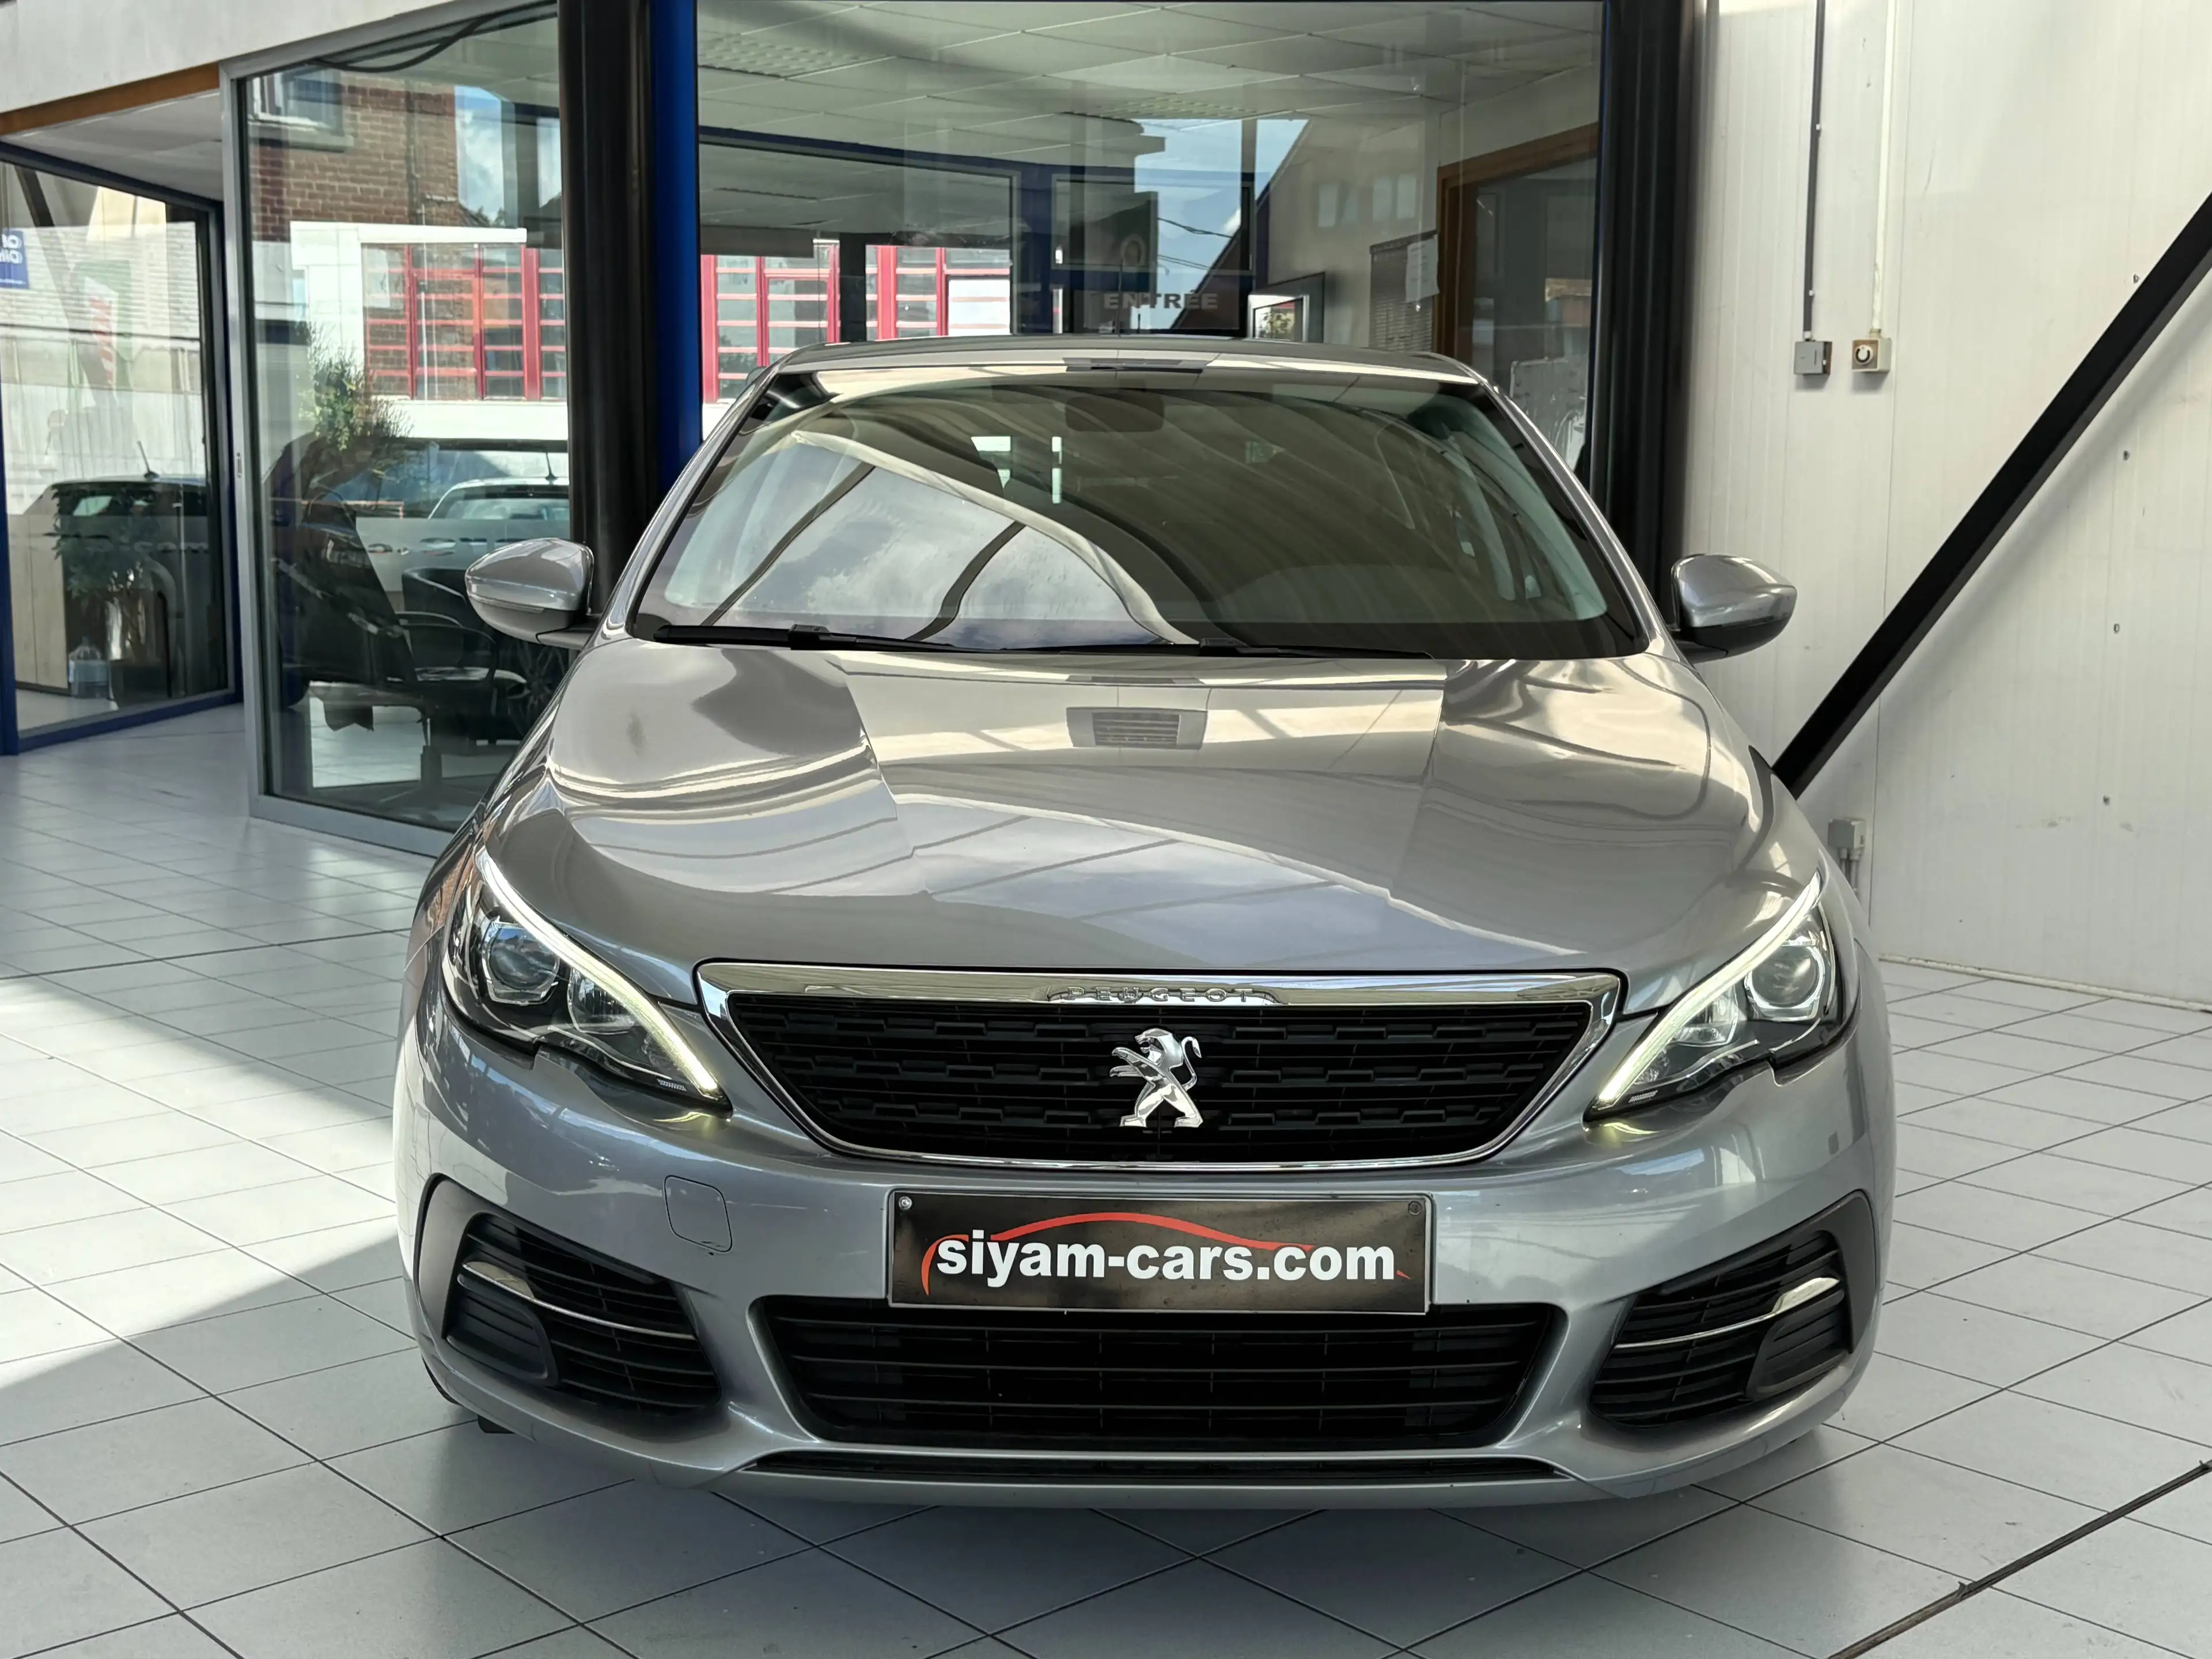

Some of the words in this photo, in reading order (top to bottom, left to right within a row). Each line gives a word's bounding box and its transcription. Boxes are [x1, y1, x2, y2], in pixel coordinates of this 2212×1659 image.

[1104, 289, 1218, 310] ENTRÉE
[1067, 986, 1253, 1002] PEUGEOT
[937, 1229, 1395, 1288] siyam-cars.com
